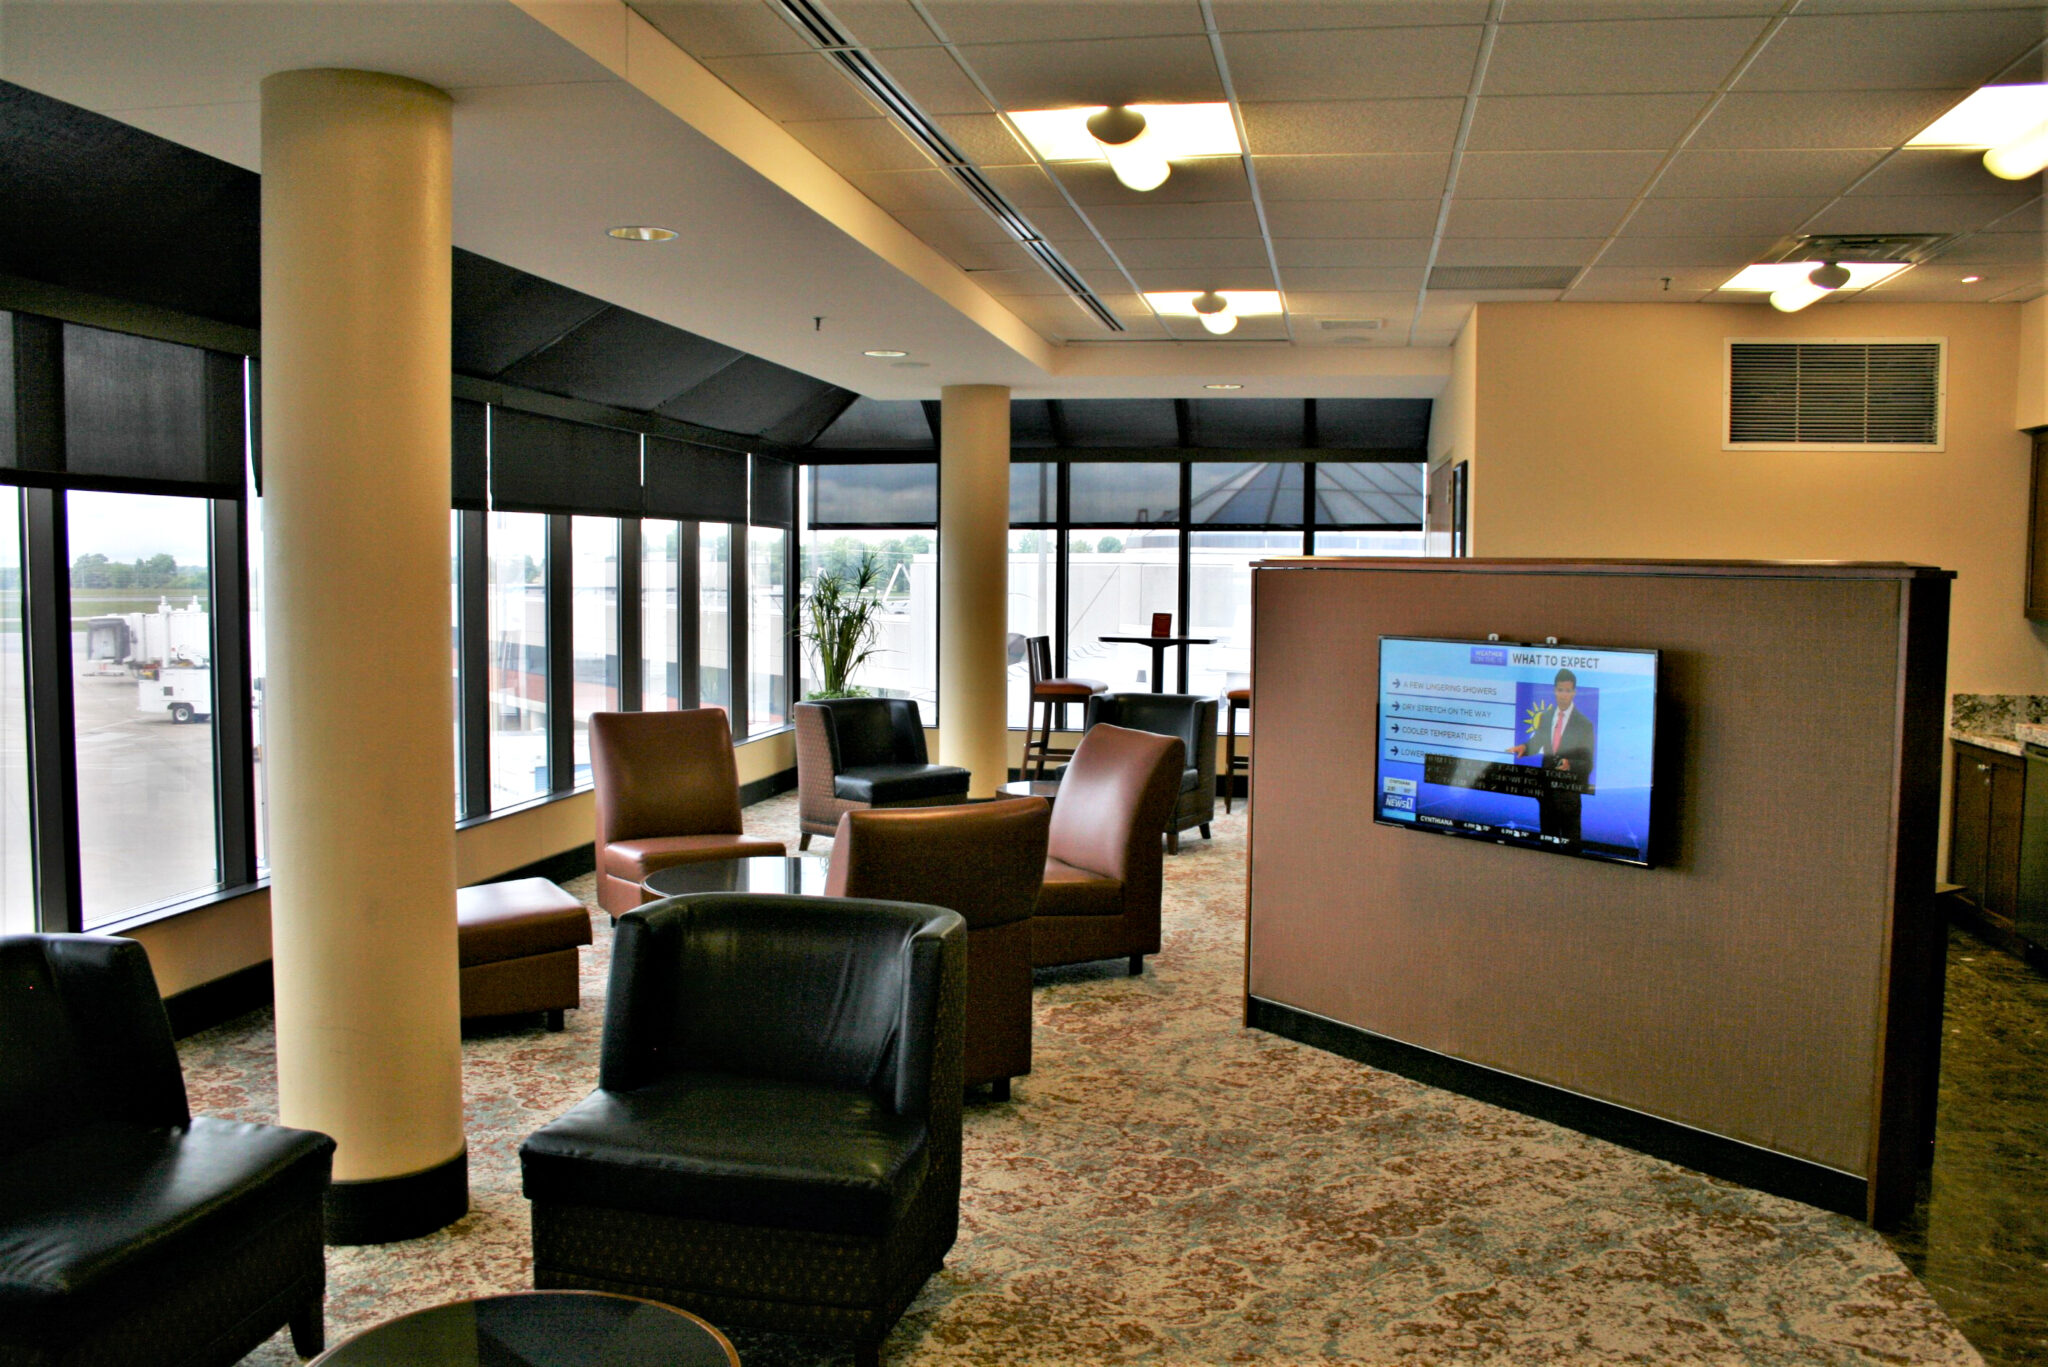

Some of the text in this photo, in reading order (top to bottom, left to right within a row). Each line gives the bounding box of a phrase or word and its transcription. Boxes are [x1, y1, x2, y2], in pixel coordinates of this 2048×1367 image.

[1512, 654, 1542, 665] WHAT
[1545, 655, 1558, 666] TO
[1560, 656, 1600, 669] EXPECT
[1426, 683, 1460, 692] LINGERING
[1463, 686, 1497, 696] SHOWERS
[1416, 705, 1446, 714] STRETCH
[1448, 707, 1458, 715] ON
[1460, 708, 1473, 716] THE
[1475, 710, 1492, 718] WAY
[1402, 726, 1482, 741] COOLER TEMPERATURES
[1401, 748, 1424, 758] LOWER
[1420, 816, 1454, 826] CYNTHIANA
